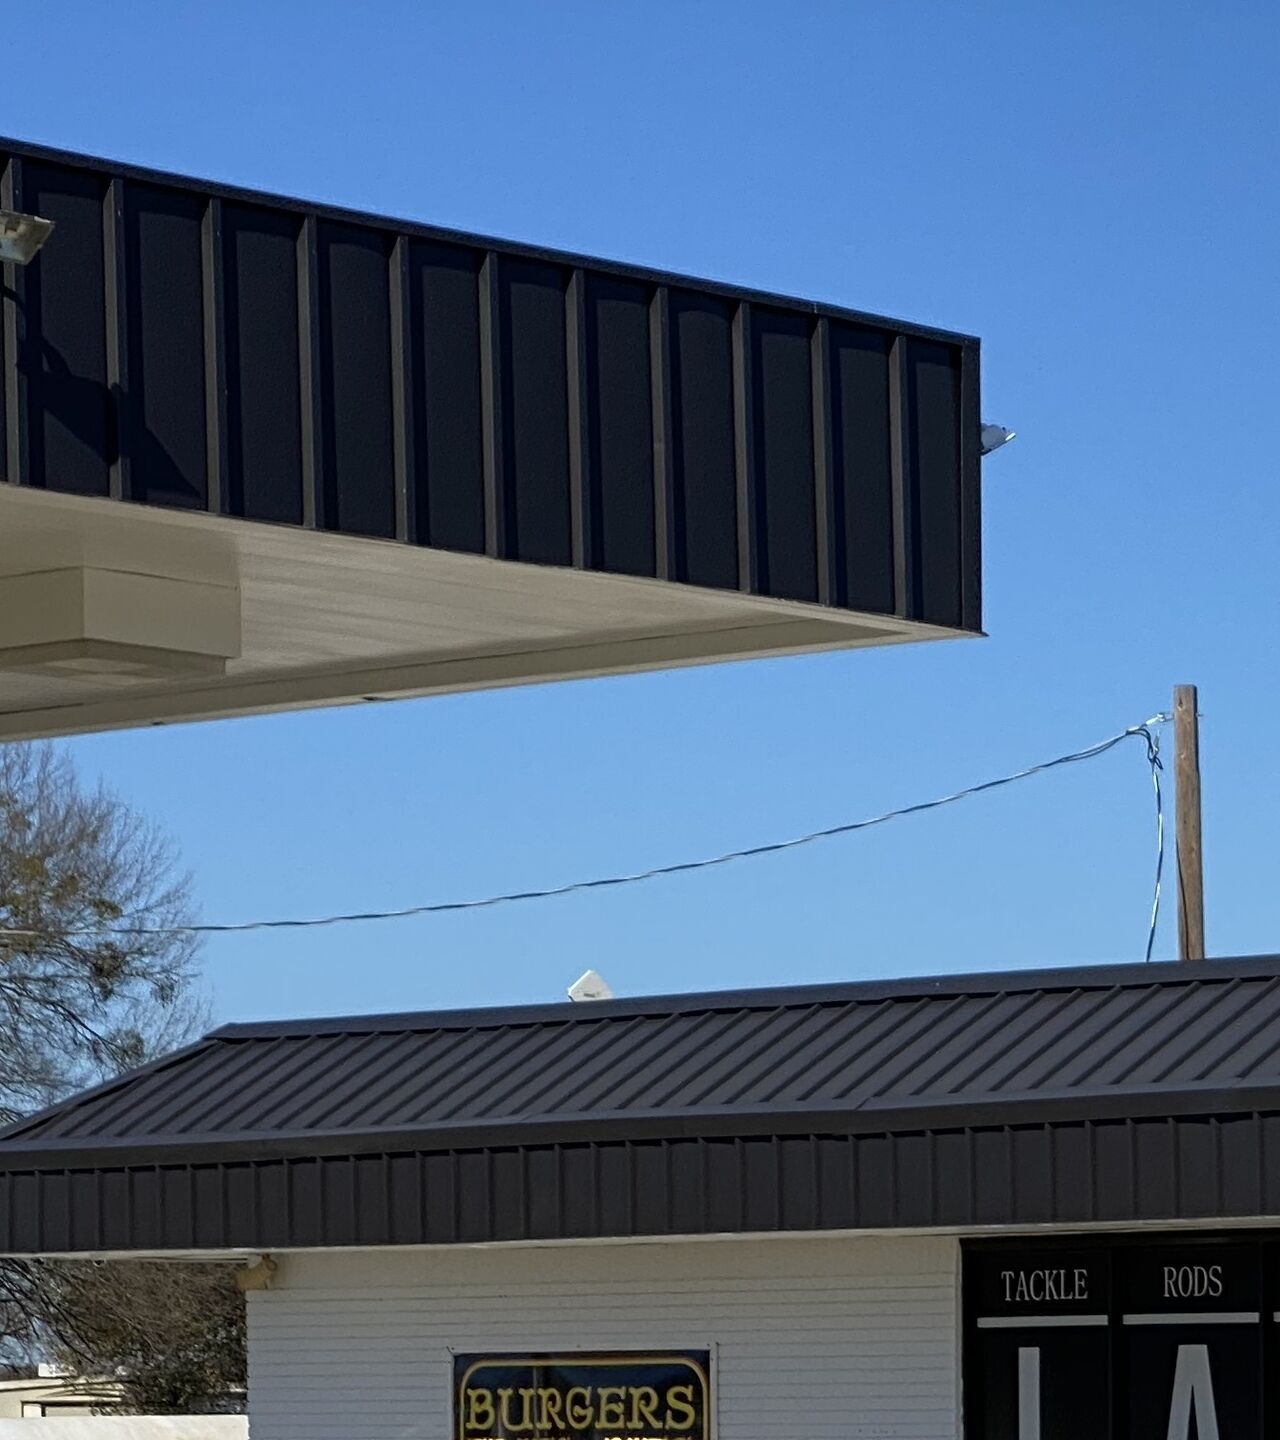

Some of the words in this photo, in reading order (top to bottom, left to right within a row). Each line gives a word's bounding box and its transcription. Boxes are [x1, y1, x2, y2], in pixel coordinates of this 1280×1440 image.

[1001, 1269, 1088, 1301] TACKLE
[1163, 1265, 1223, 1297] RODS
[465, 1384, 697, 1431] BURGERS
